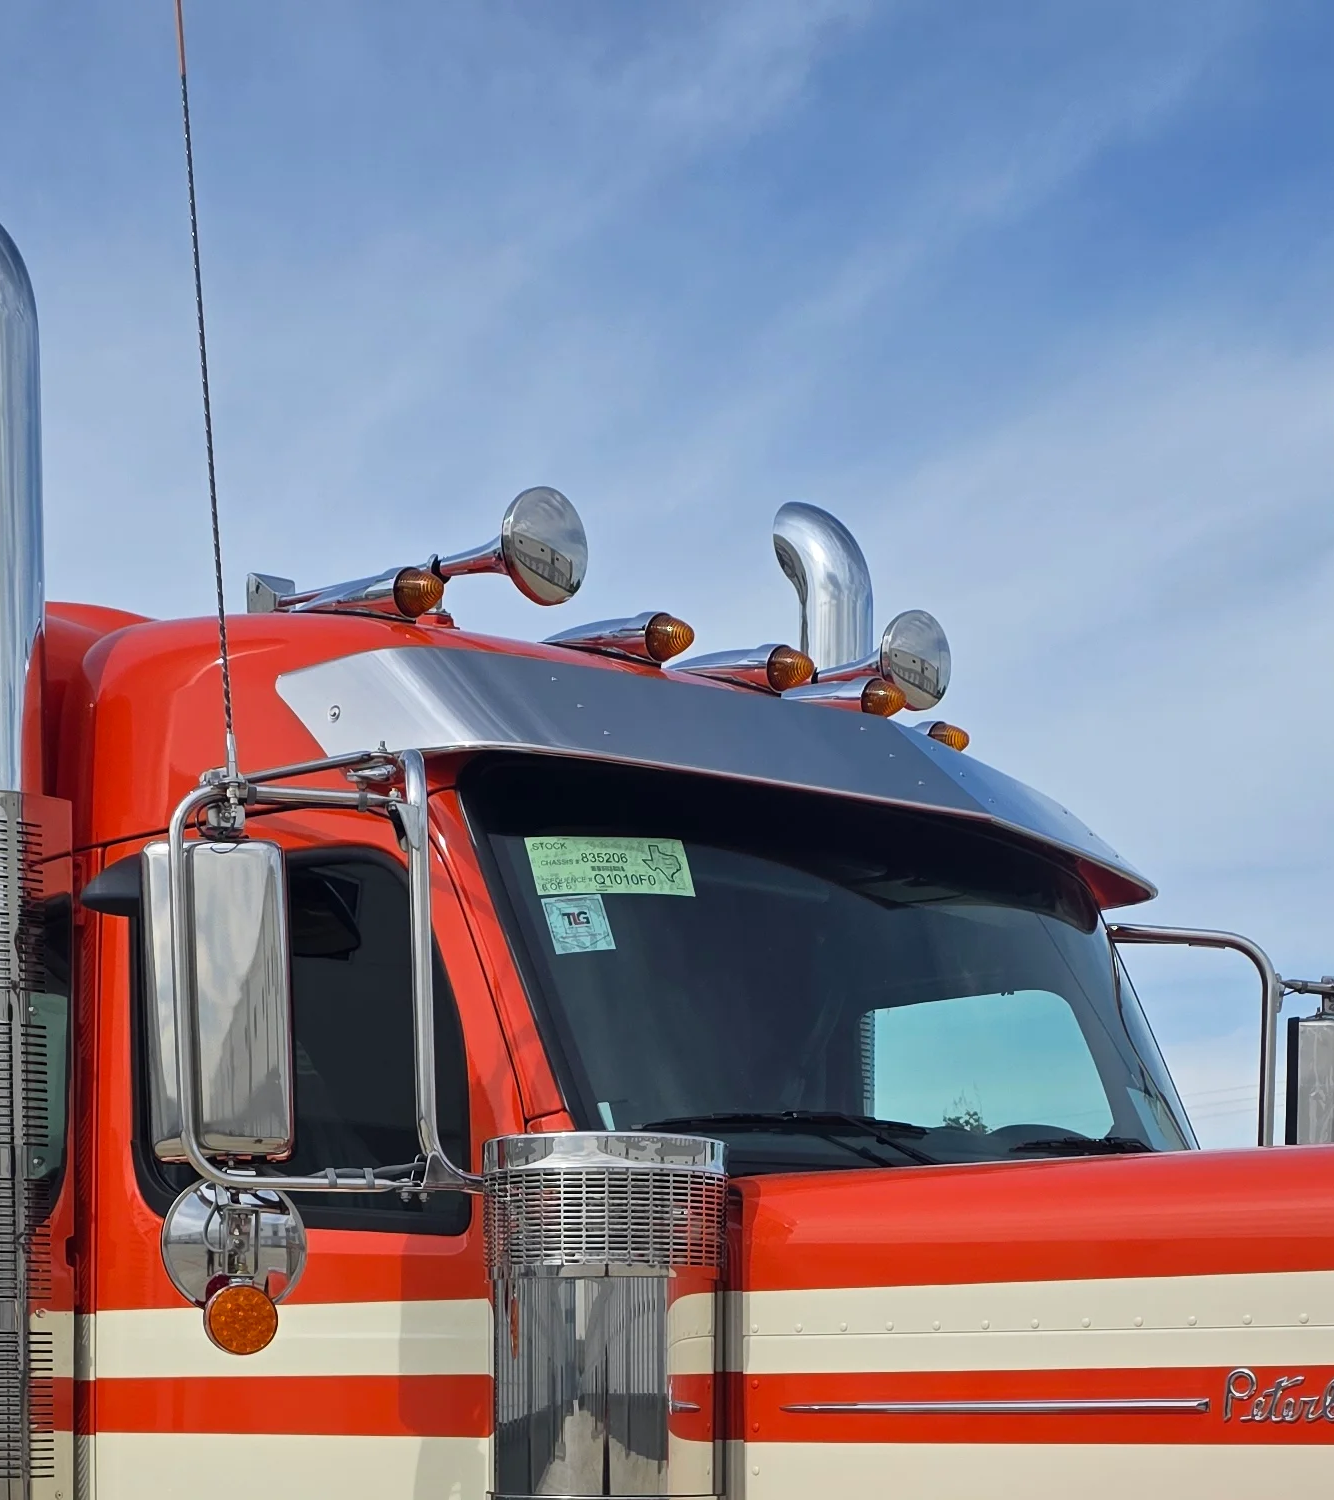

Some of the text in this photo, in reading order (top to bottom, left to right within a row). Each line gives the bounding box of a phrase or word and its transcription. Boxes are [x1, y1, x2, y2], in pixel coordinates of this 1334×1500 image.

[532, 842, 567, 850] STOCK
[581, 852, 628, 863] 835206
[594, 873, 656, 886] Q1010F0
[550, 882, 562, 890] OF
[562, 911, 590, 926] TLG
